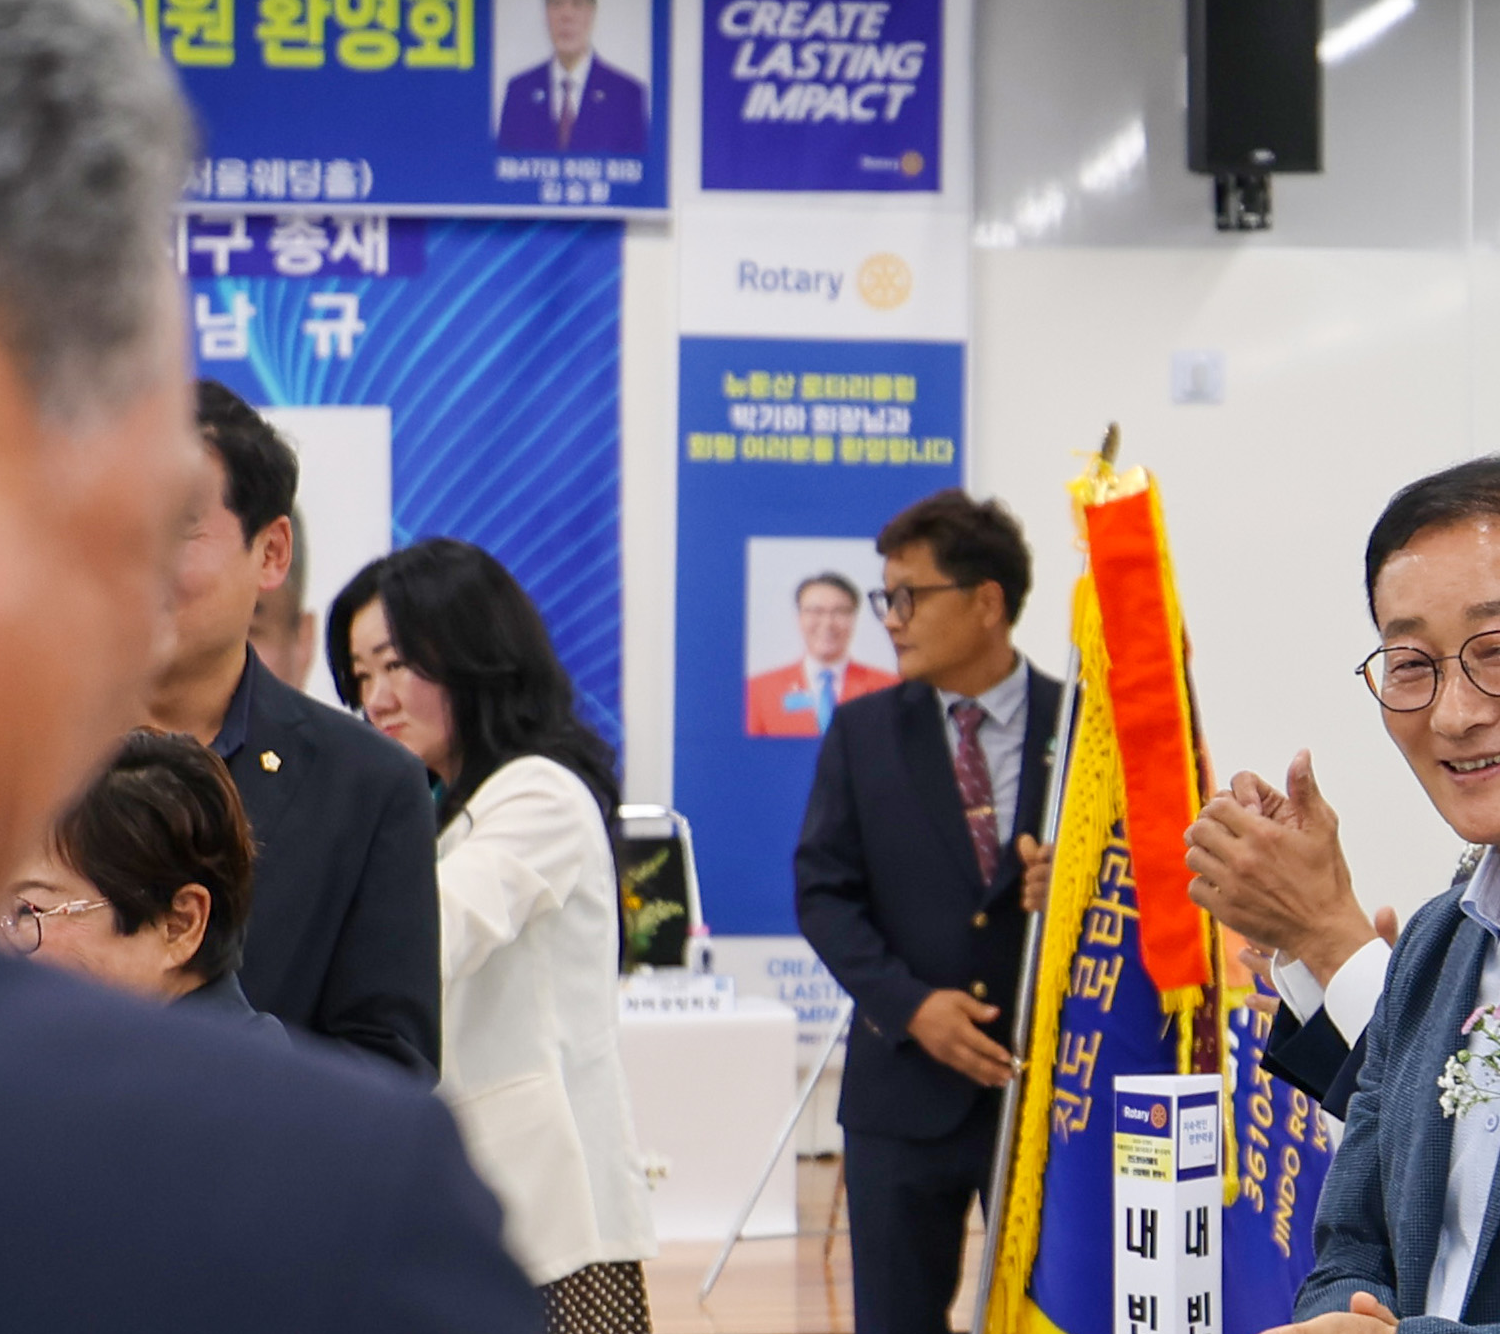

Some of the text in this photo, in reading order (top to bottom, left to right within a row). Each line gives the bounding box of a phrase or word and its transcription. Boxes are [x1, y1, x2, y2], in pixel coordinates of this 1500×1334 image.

[731, 40, 927, 82] LASTING
[742, 81, 917, 123] IMPACT
[176, 216, 254, 276] 구
[736, 260, 844, 303] Rotary
[1123, 1105, 1150, 1123] Rotary
[1271, 1088, 1309, 1259] JINDO RO
